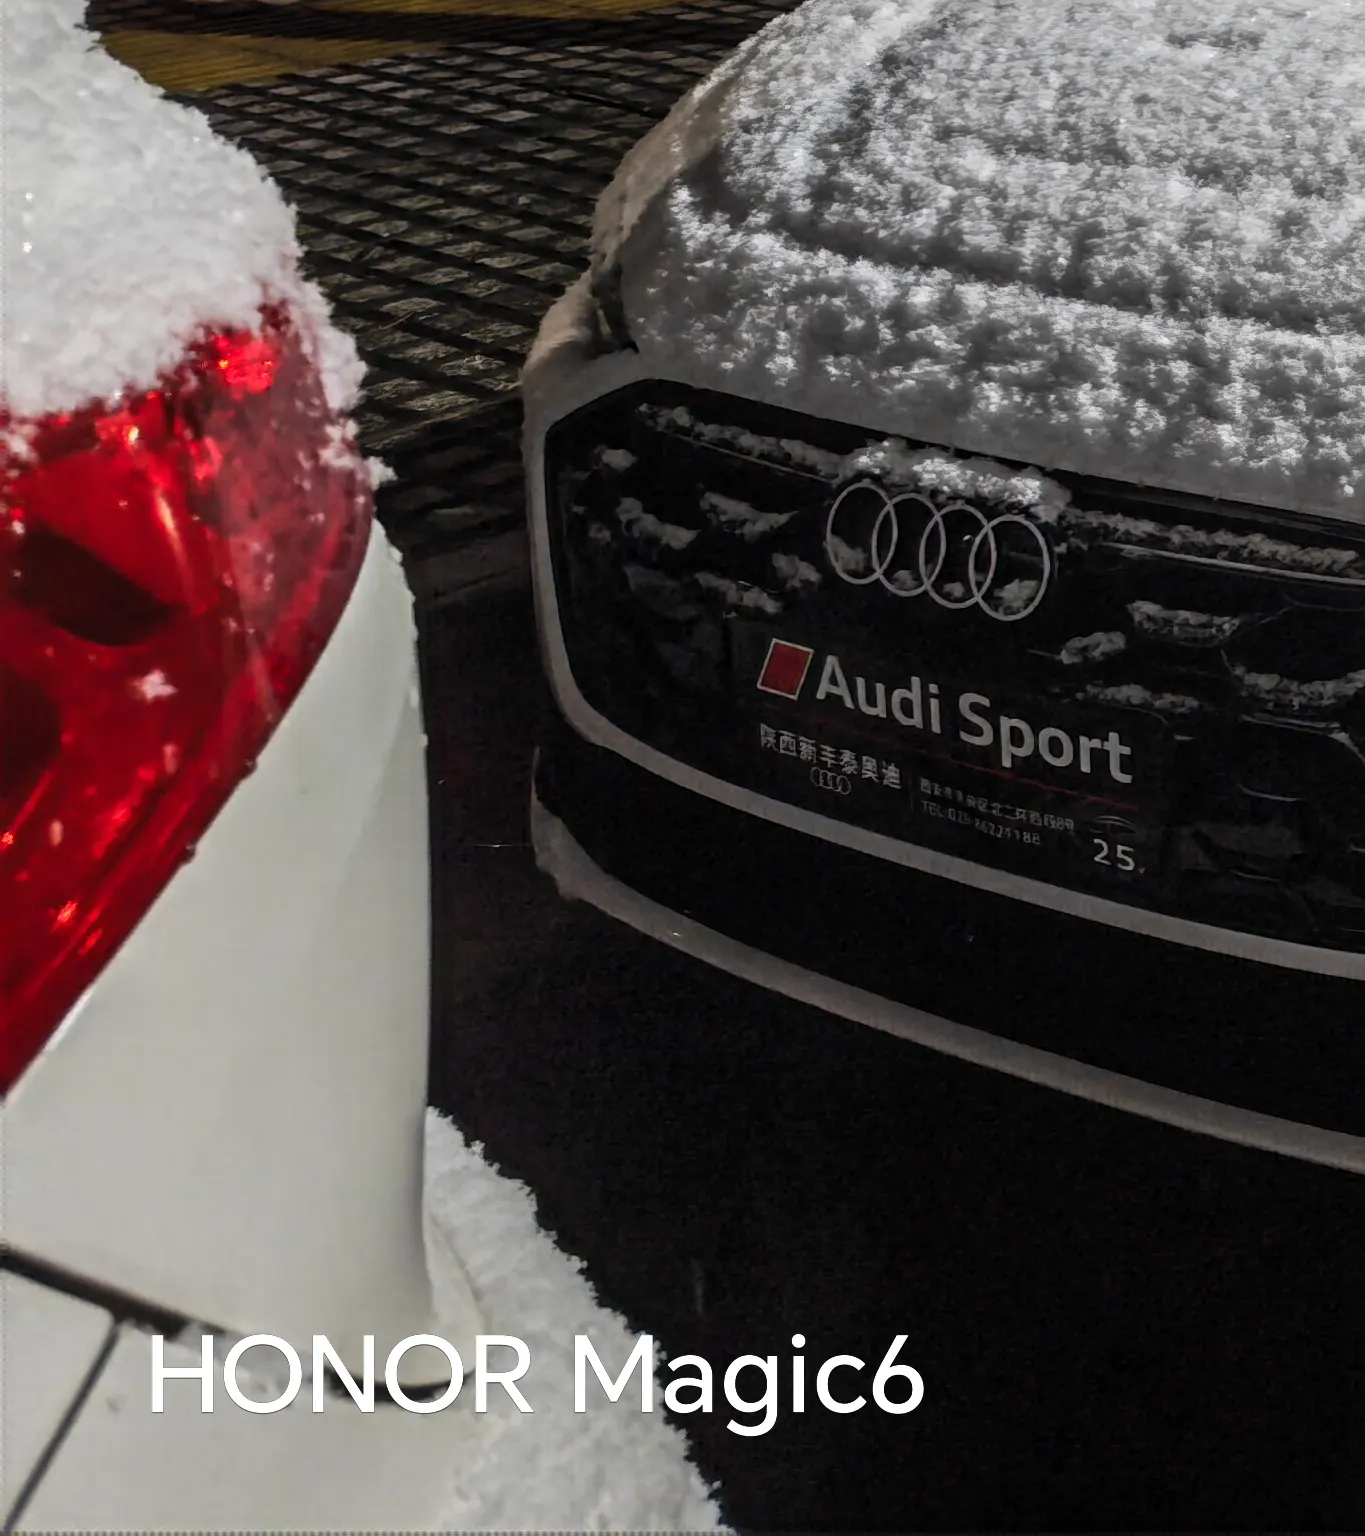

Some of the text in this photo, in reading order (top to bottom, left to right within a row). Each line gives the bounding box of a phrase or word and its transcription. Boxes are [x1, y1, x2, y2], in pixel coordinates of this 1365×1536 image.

[815, 654, 1136, 785] Audi Sport
[1092, 837, 1136, 872] 25
